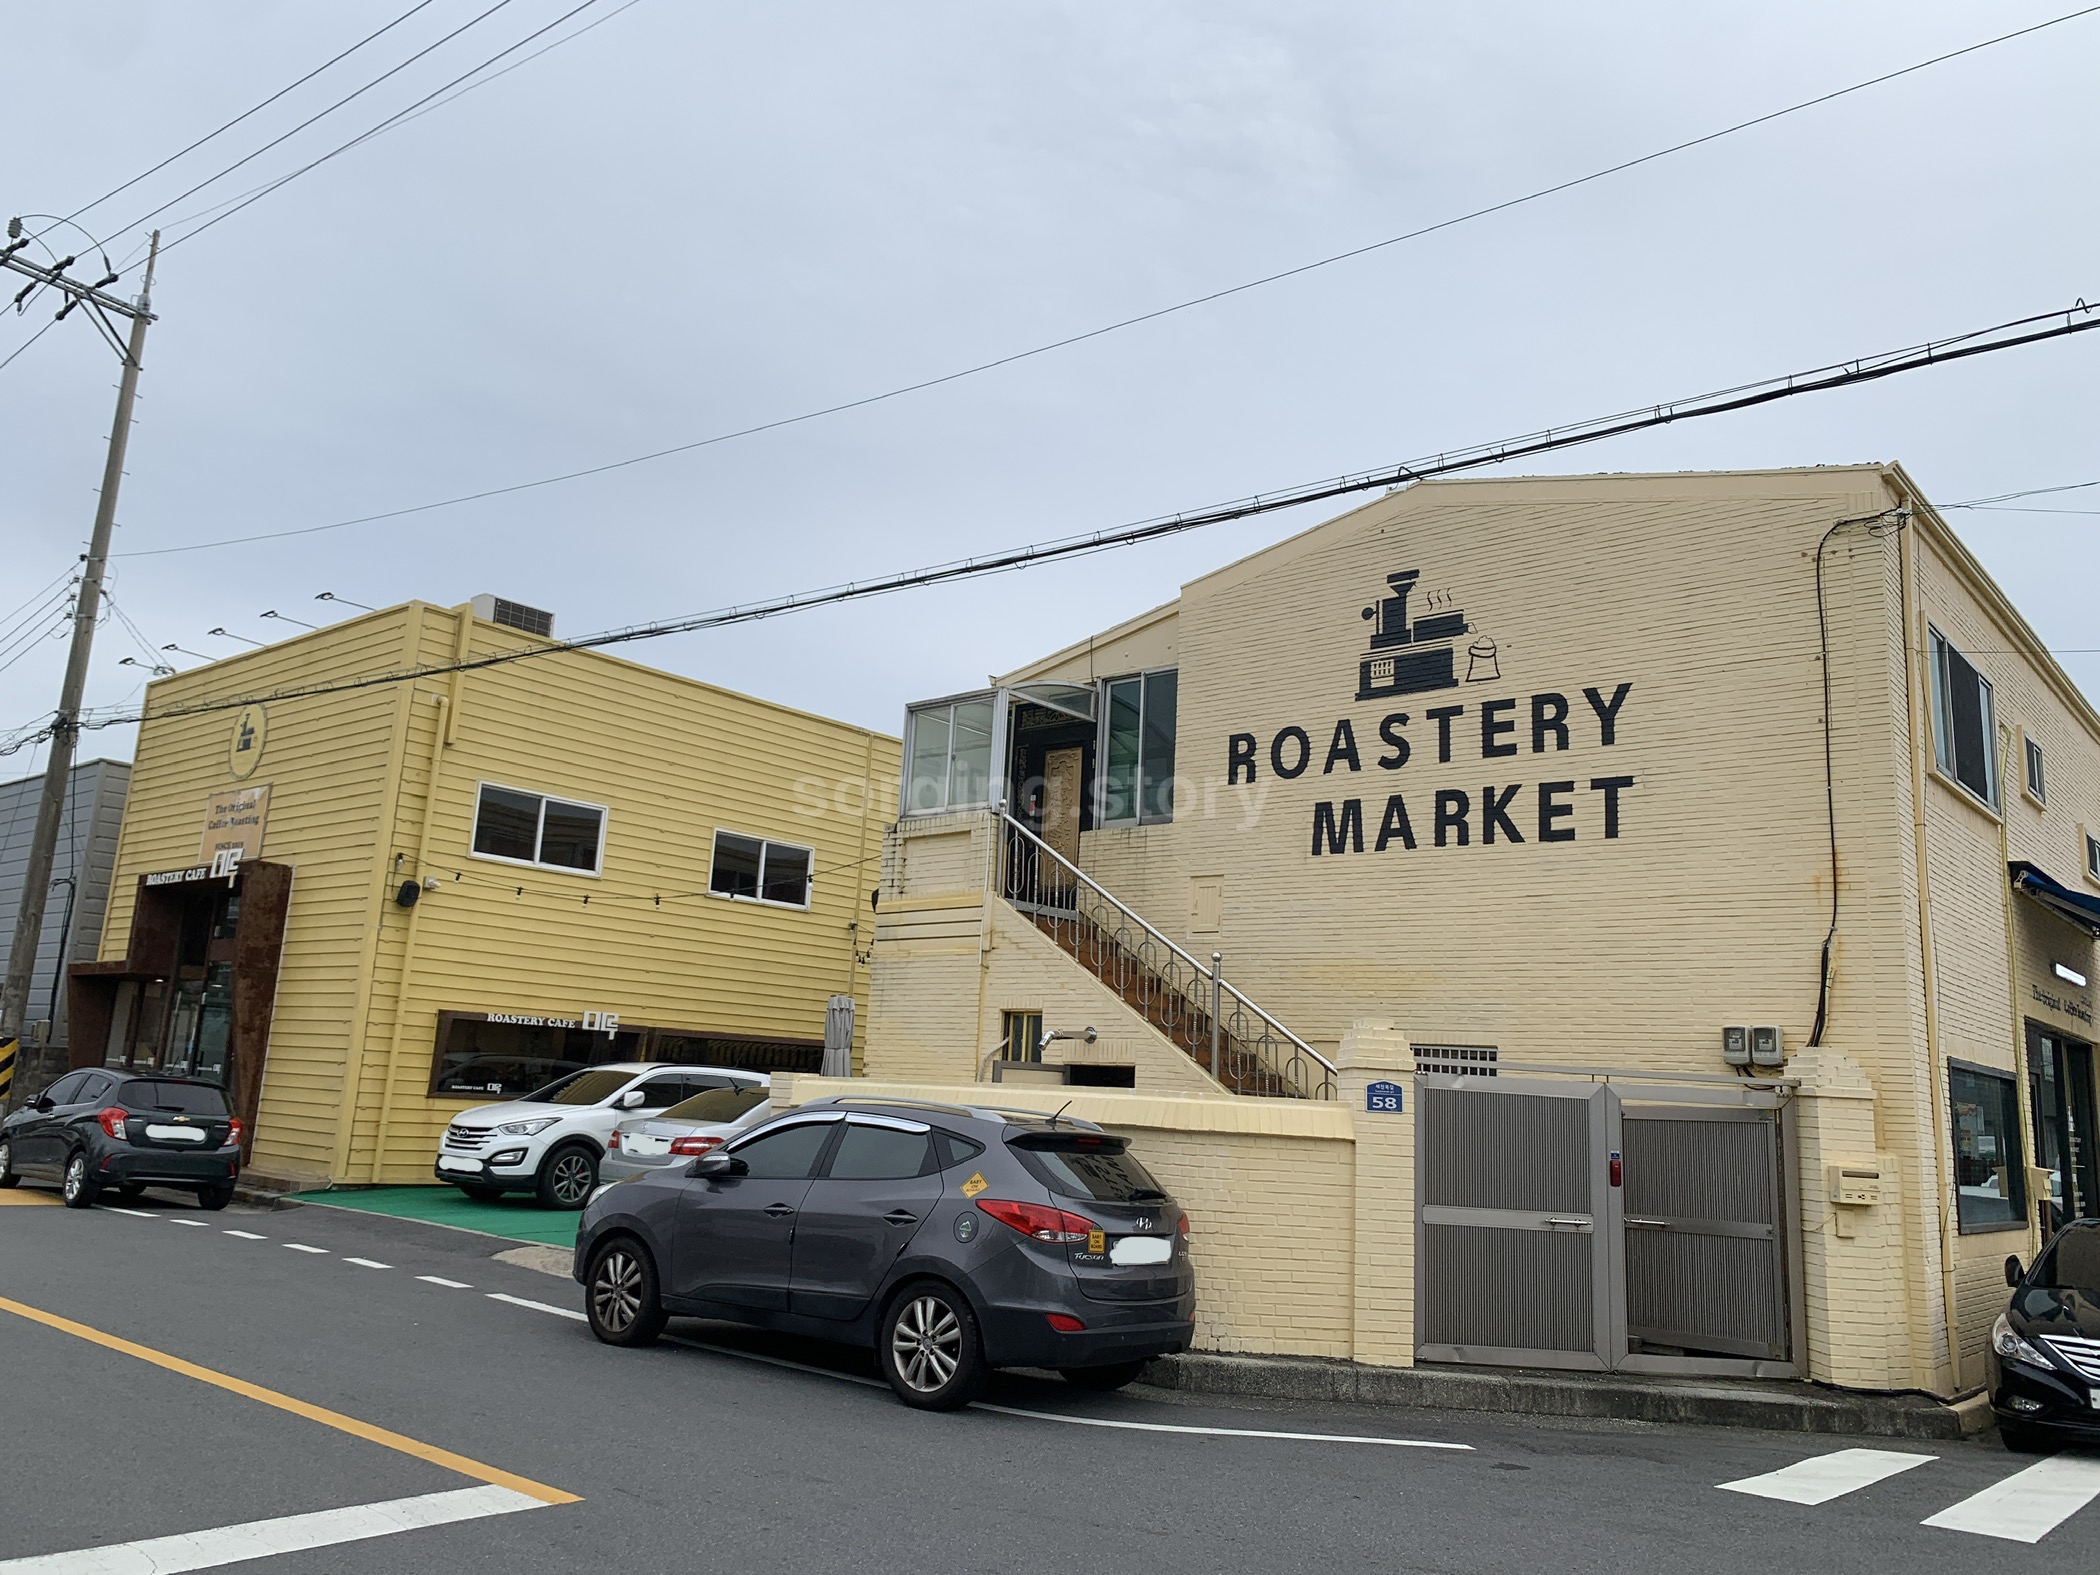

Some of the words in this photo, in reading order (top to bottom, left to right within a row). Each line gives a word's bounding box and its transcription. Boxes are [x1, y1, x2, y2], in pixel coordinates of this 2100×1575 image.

[1227, 683, 1633, 785] ROASTERY
[1311, 776, 1635, 856] MARKET
[146, 872, 184, 885] ROASTERY
[185, 868, 206, 880] CAFE
[487, 1013, 545, 1026] ROASTERY
[547, 1017, 576, 1028] CAFE
[1372, 1097, 1397, 1109] 58
[1074, 1252, 1104, 1260] Tucson
